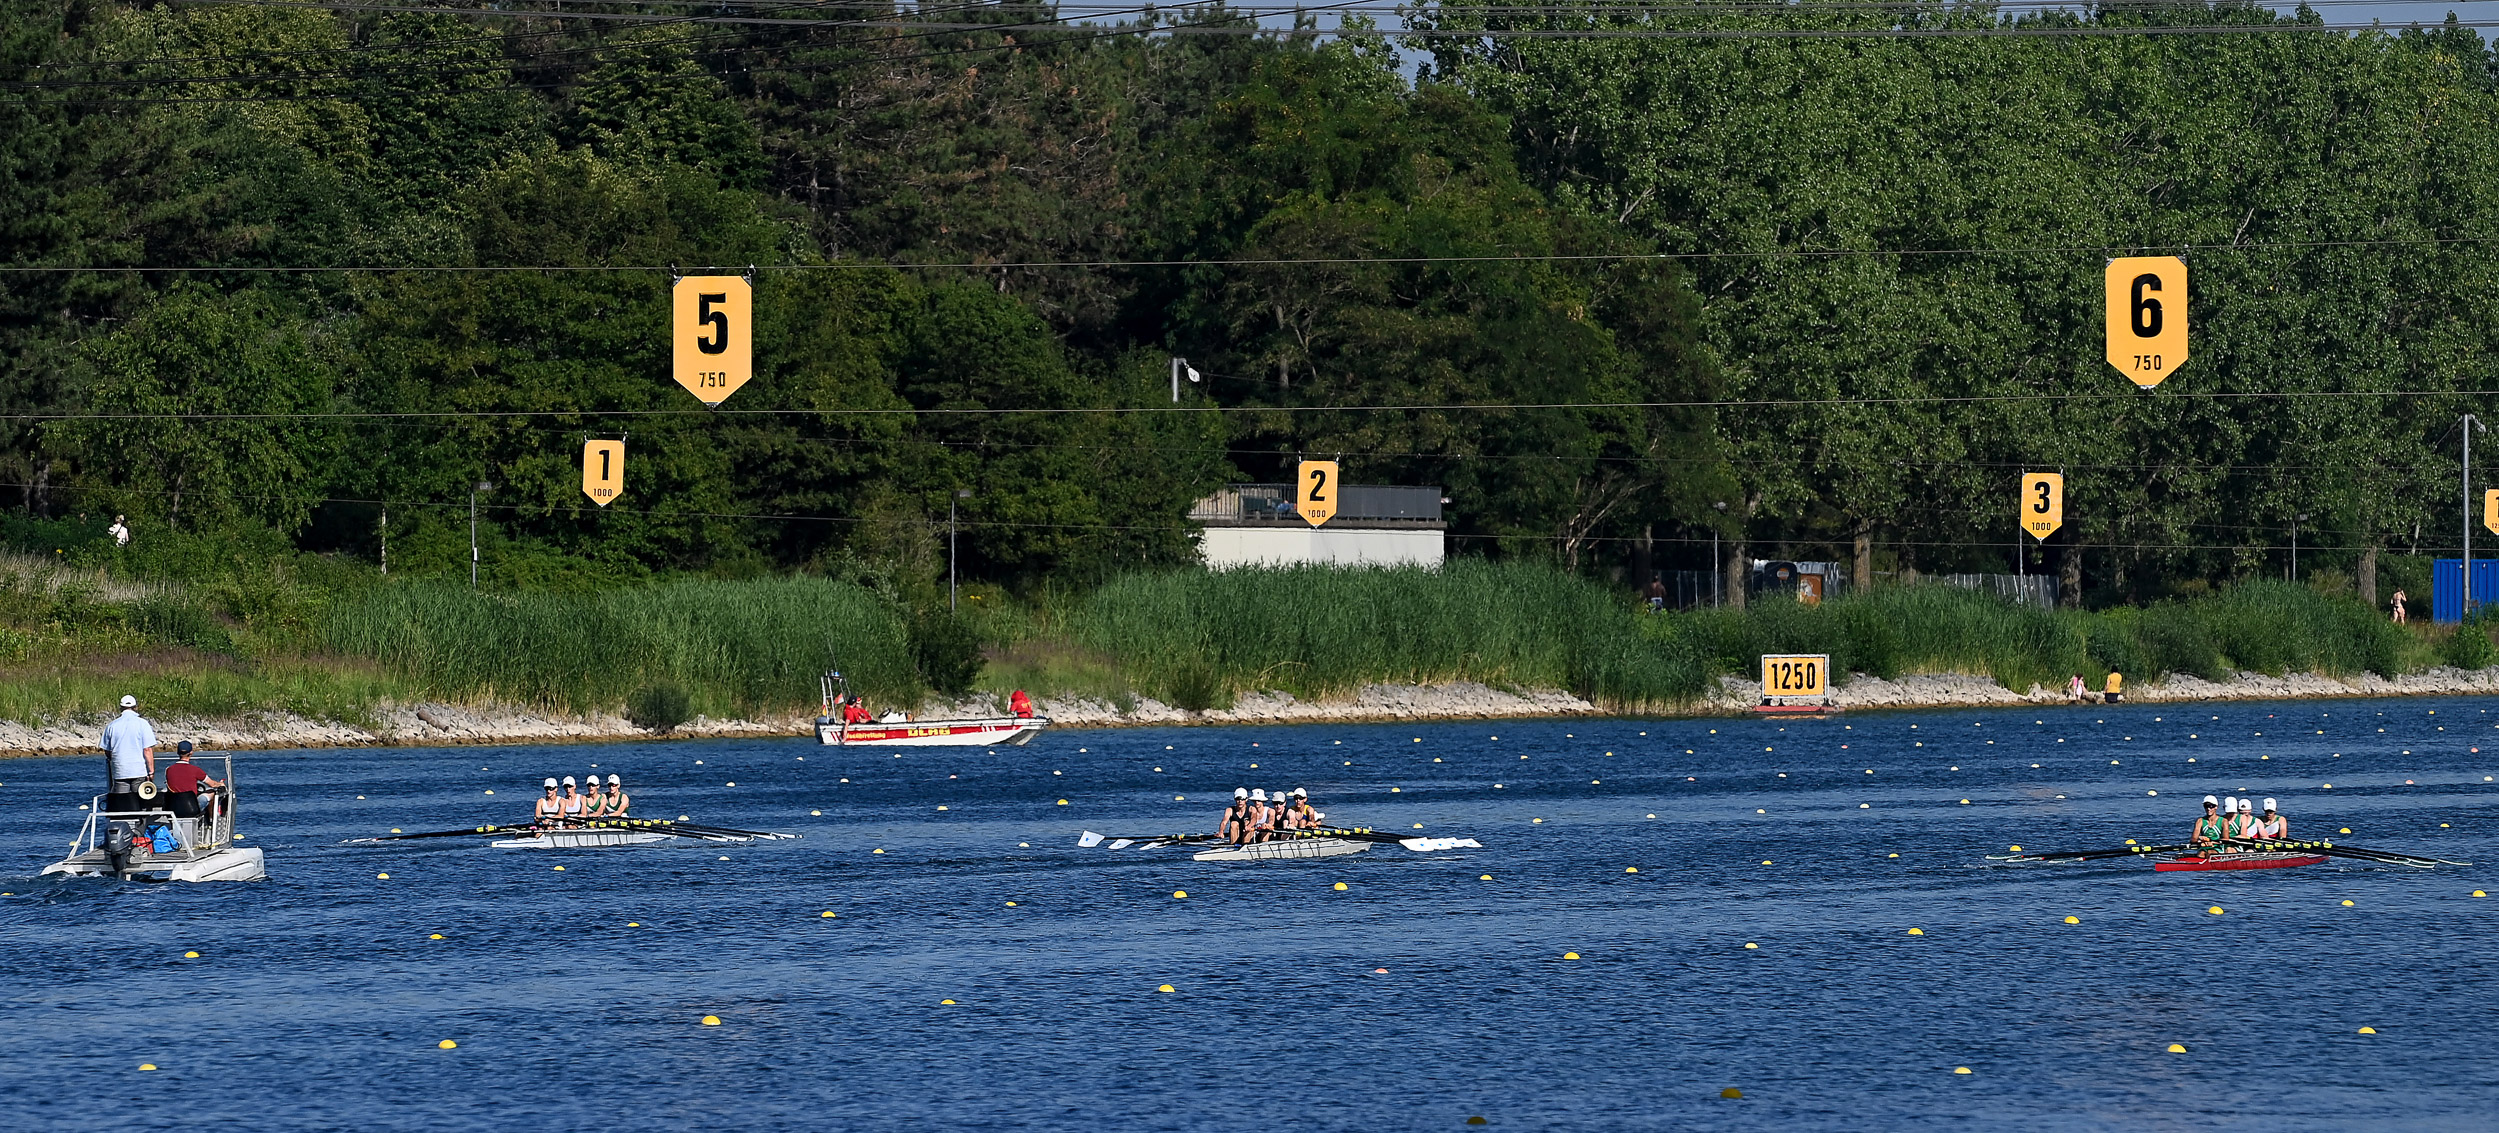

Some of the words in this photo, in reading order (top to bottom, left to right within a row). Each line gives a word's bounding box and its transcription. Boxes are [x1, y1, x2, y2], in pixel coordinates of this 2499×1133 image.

[2130, 273, 2163, 338] 6
[697, 292, 728, 355] 5
[2133, 354, 2162, 371] 750
[698, 371, 726, 388] 750
[599, 449, 610, 481] 1
[593, 488, 613, 497] 1000
[1309, 469, 1326, 502] 2
[2033, 481, 2051, 514] 3
[1307, 509, 1326, 518] 1000
[2031, 522, 2051, 531] 1000
[1771, 662, 1816, 690] 1250
